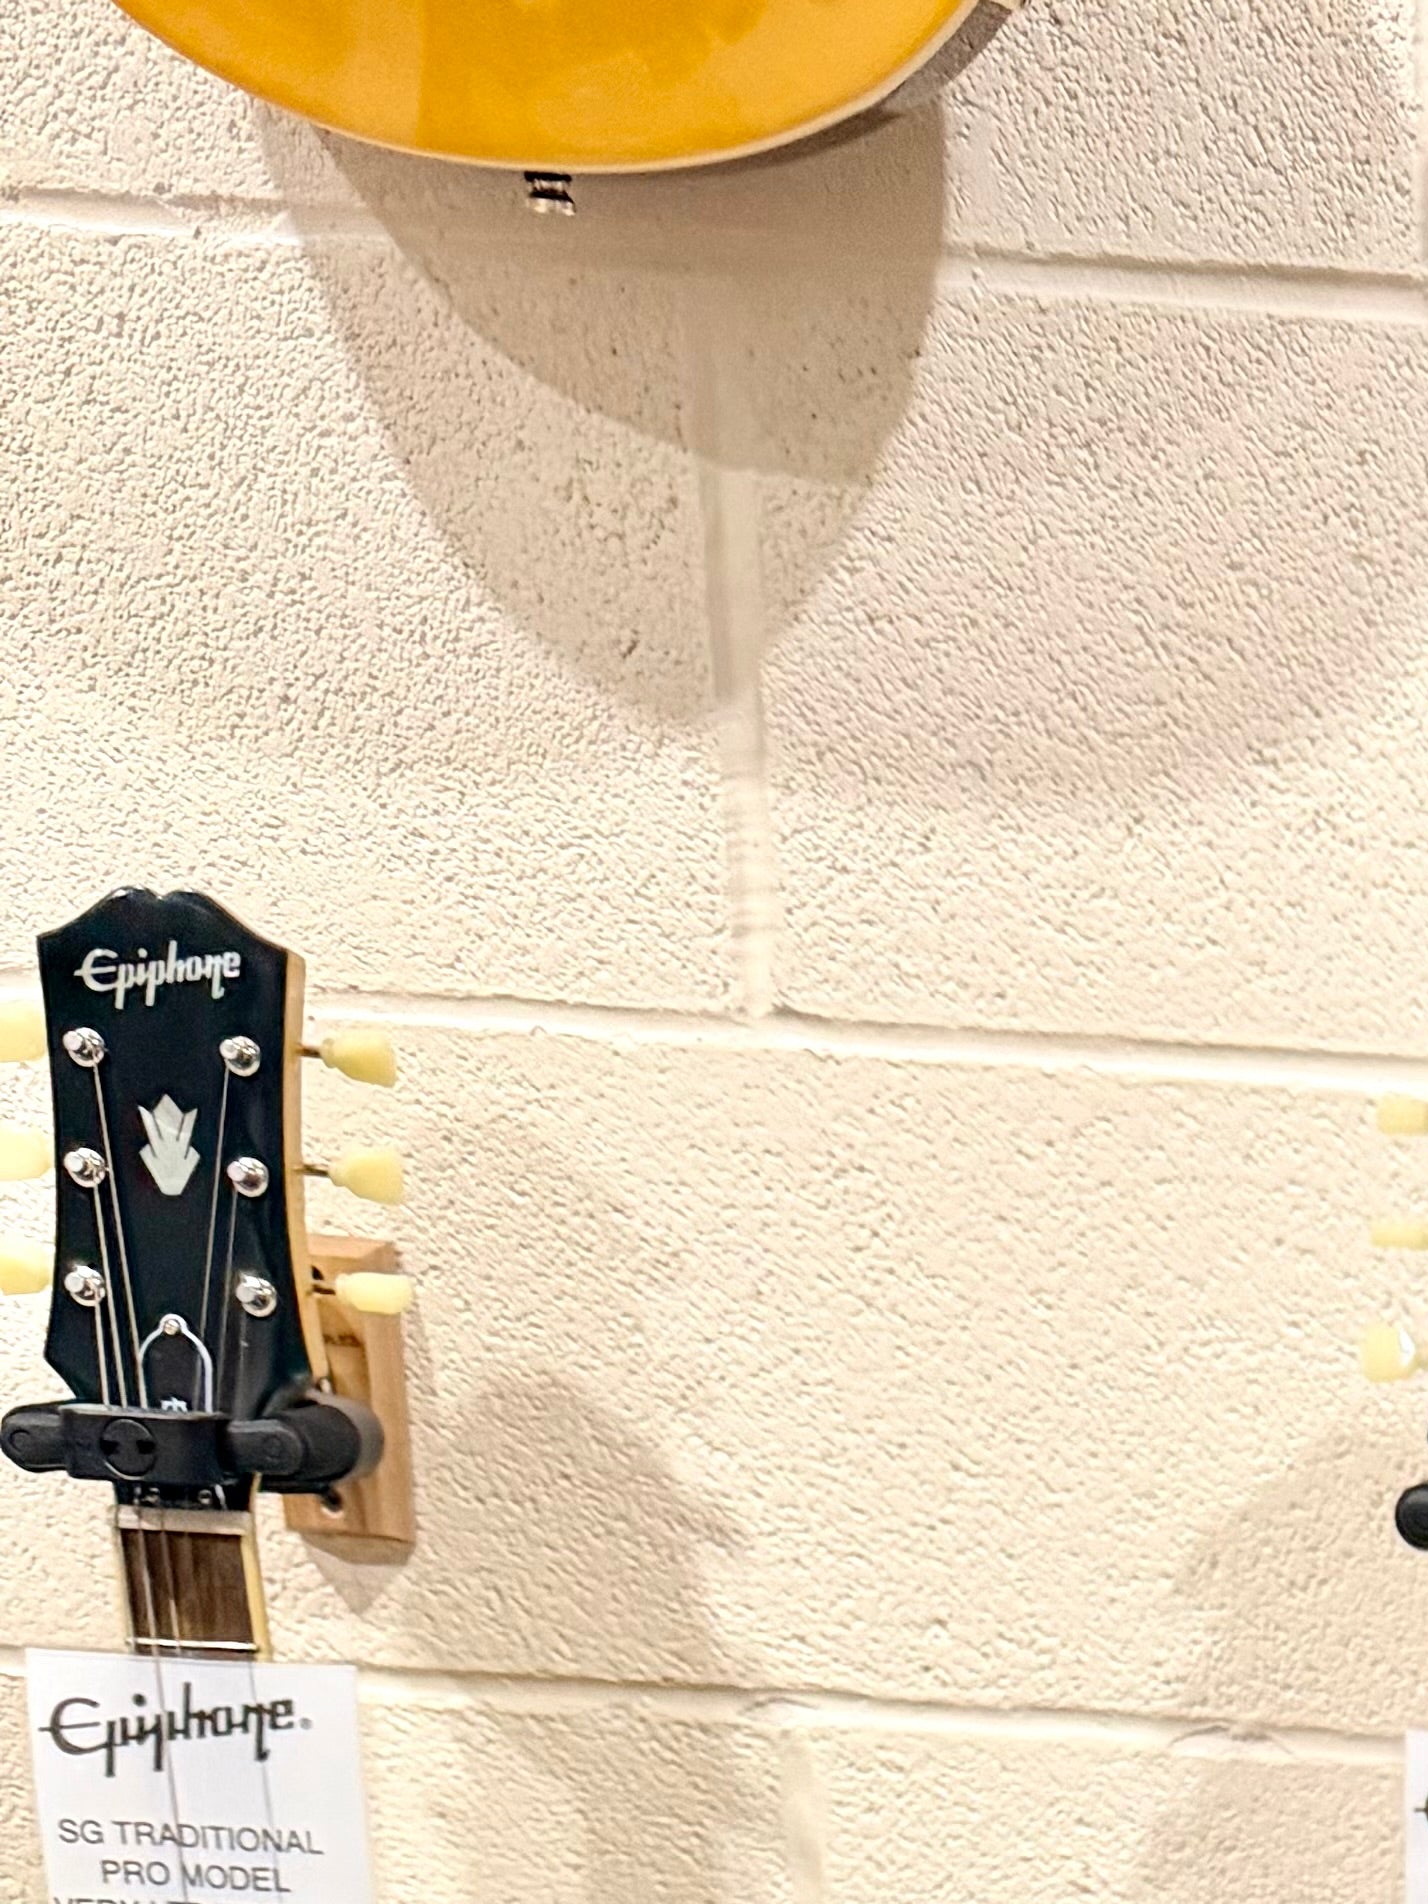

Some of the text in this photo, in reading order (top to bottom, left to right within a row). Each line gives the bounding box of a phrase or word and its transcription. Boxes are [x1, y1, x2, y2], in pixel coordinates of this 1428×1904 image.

[74, 940, 241, 1009] Epiphone
[38, 1682, 294, 1777] Epiphone
[58, 1819, 324, 1855] SG TRADITIONAL
[101, 1860, 291, 1893] PRO MODEL
